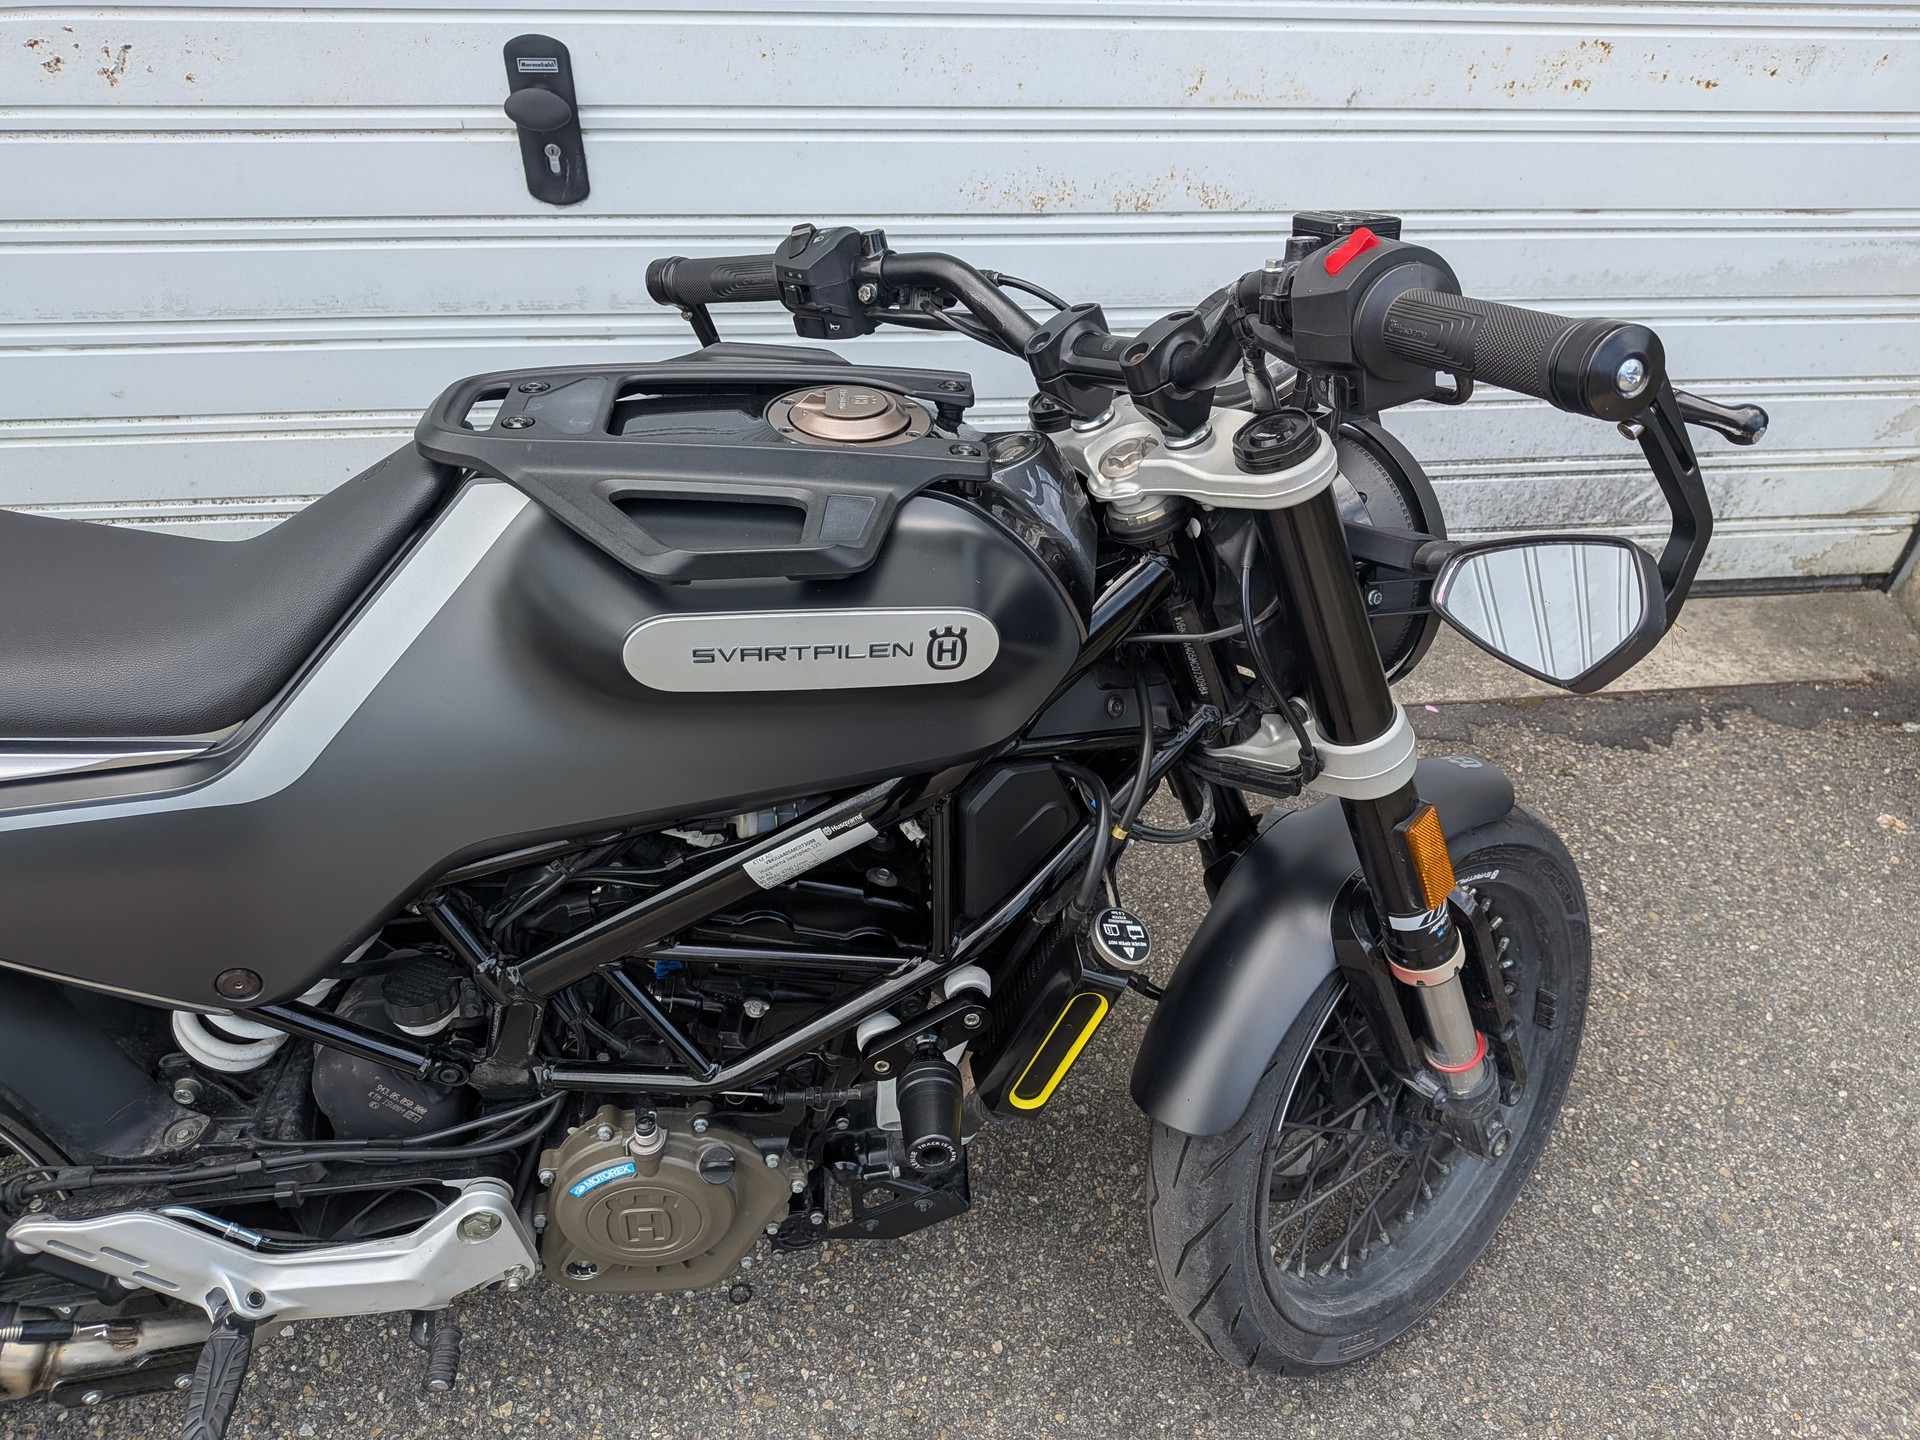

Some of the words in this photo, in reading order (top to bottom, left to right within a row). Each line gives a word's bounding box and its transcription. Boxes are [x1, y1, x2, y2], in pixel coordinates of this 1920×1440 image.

[691, 641, 914, 664] SVARTPILEN
[831, 812, 864, 832] Husqvarna
[759, 858, 786, 875] Husqvarna
[810, 841, 821, 849] 125
[917, 1141, 940, 1150] TRACK
[584, 1164, 631, 1188] MOTOREX
